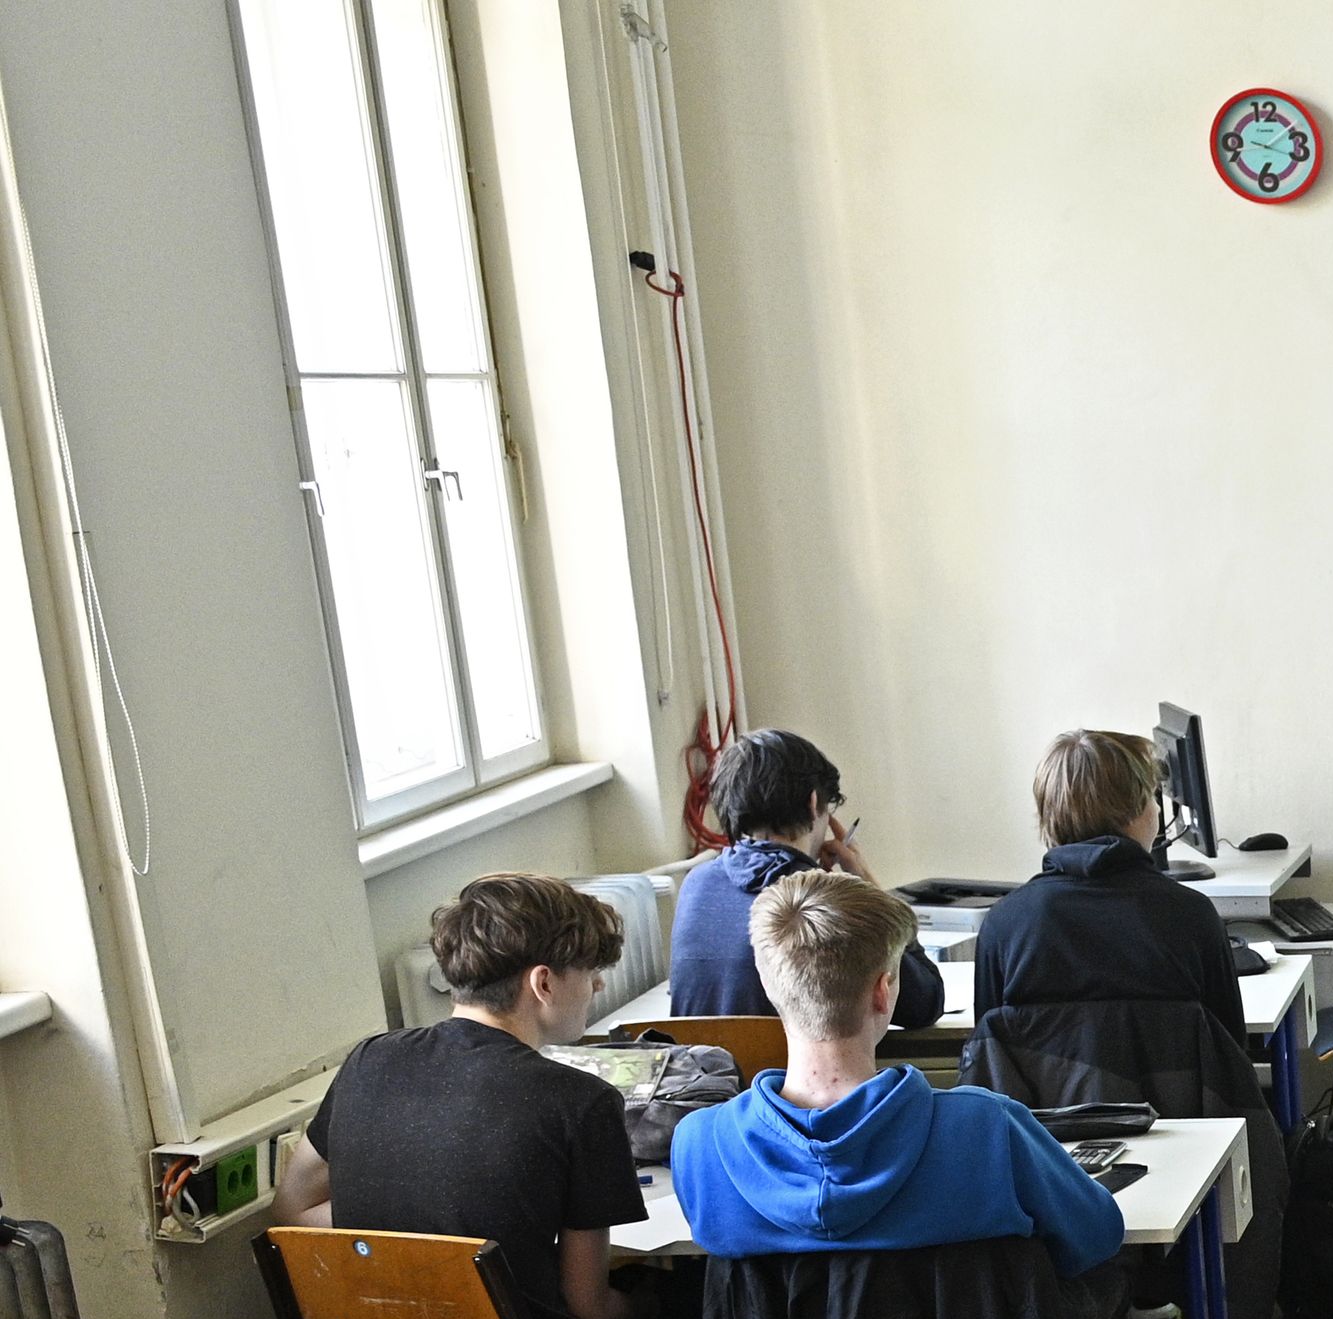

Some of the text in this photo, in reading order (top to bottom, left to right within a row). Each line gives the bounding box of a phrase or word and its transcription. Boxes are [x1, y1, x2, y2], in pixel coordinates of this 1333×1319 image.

[1250, 101, 1277, 123] 12
[1222, 132, 1243, 162] 9
[1288, 131, 1310, 162] 3
[1258, 162, 1280, 193] 6
[357, 1241, 369, 1256] 6
